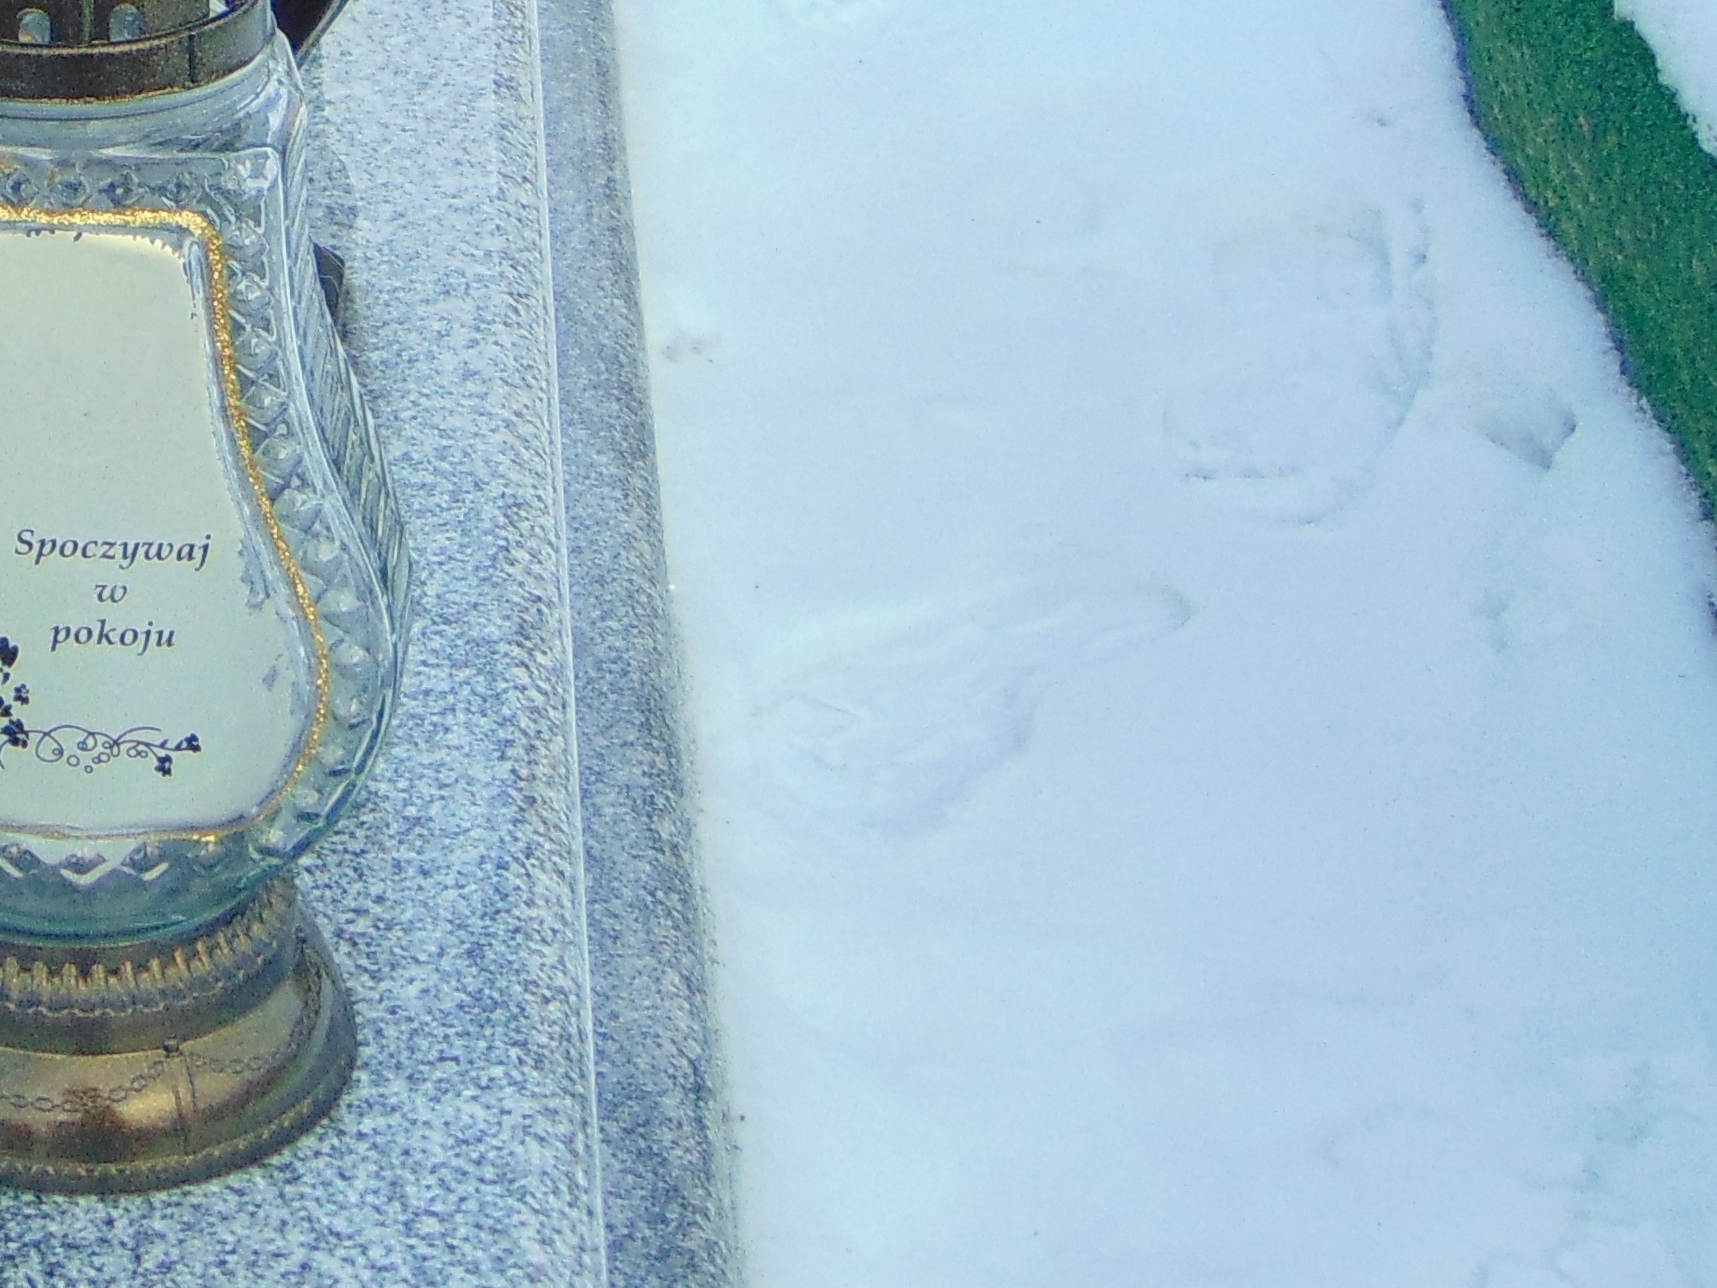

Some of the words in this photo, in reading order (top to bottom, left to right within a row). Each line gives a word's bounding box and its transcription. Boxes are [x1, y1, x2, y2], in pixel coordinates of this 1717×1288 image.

[14, 528, 212, 572] Spoczywaj
[94, 583, 129, 604] w
[50, 618, 177, 657] pokoju
